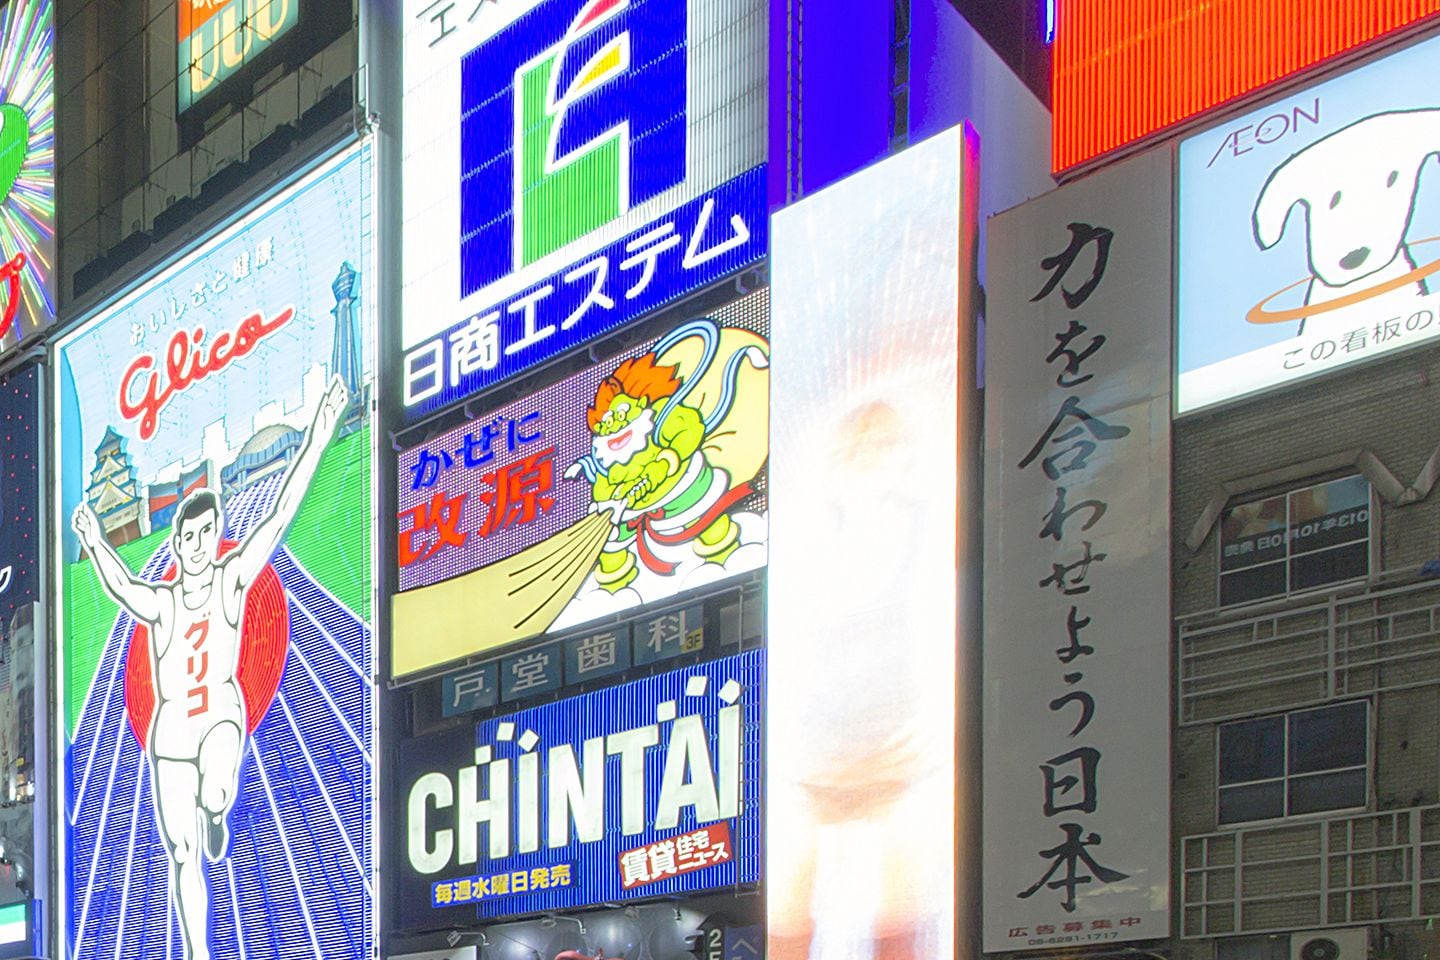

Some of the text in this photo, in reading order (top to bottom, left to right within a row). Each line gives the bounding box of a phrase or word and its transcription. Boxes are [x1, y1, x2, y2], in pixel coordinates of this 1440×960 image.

[129, 235, 275, 347] おいしさと健康
[404, 197, 750, 407] 日商エステム
[120, 307, 296, 441] Glico
[1282, 308, 1440, 371] この看板の
[410, 410, 541, 491] かぜに
[397, 447, 558, 568] 改源
[1017, 221, 1131, 913] 力を合わせよう日本
[183, 610, 210, 718] グリコ
[685, 635, 702, 651] 3F
[620, 844, 675, 887] 賃貸
[676, 830, 709, 853] 住宅
[678, 842, 729, 873] ニュース
[434, 864, 571, 904] 毎週水曜日発売
[1007, 917, 1143, 939] 広告募集中
